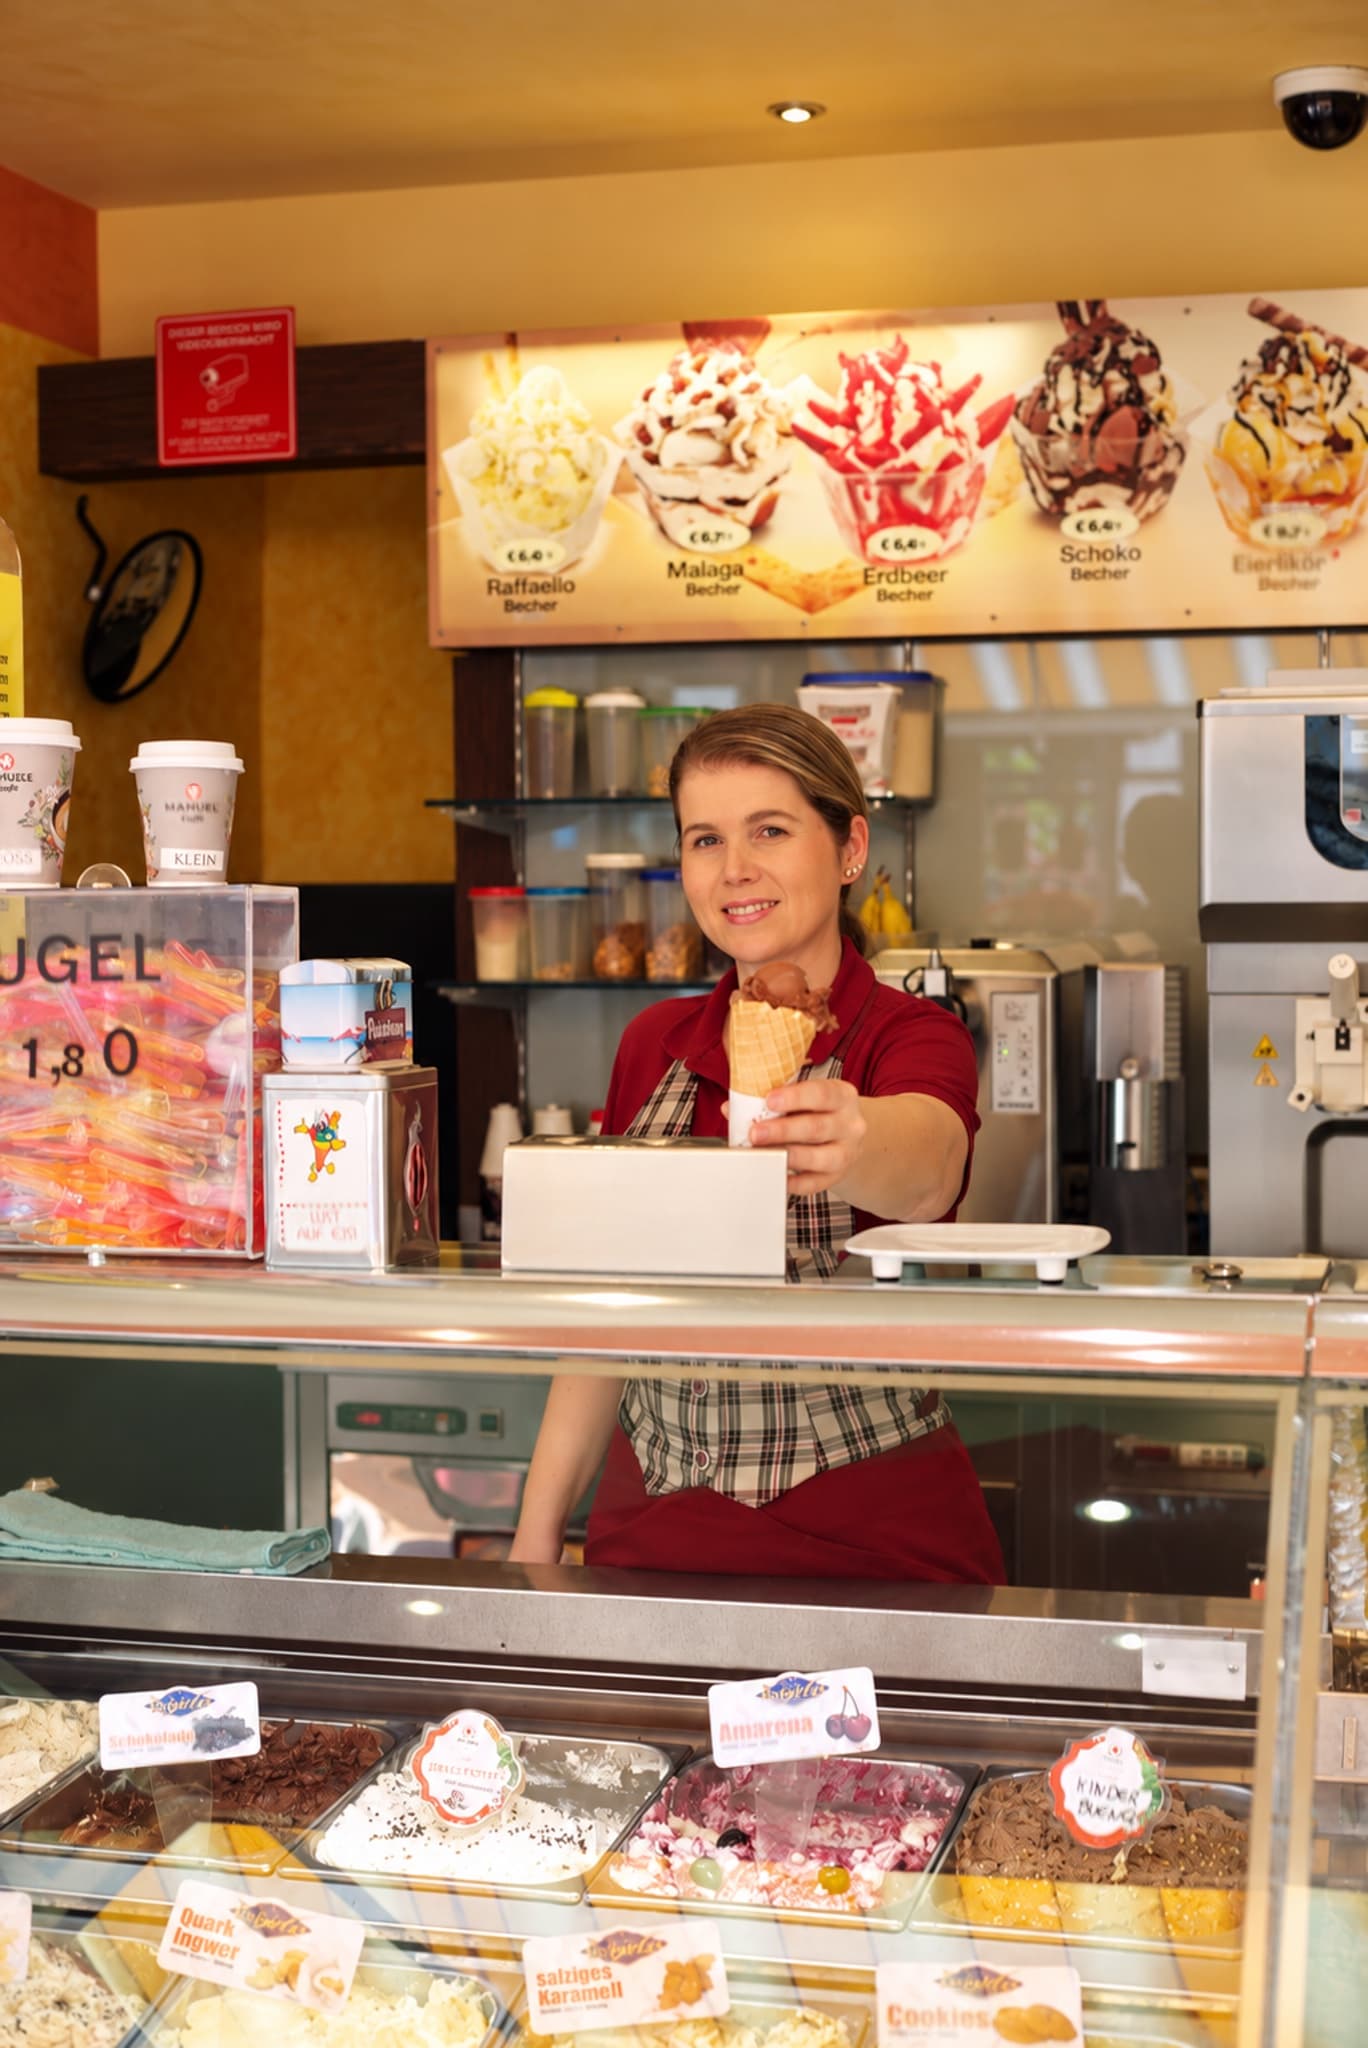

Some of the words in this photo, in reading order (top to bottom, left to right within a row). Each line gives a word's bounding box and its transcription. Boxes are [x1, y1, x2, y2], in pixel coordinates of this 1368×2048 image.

[1060, 544, 1142, 563] Schoko
[667, 560, 744, 581] Malaga
[863, 566, 949, 586] Erdbeer
[1071, 567, 1130, 581] Becher
[487, 576, 576, 596] Raffaello
[685, 582, 742, 597] Becher
[877, 588, 934, 602] Becher
[504, 598, 558, 613] Becher
[165, 802, 218, 813] MANUEL
[0, 850, 33, 865] OSS
[174, 853, 217, 866] KLEIN
[108, 1729, 195, 1749] Schokolade
[719, 1716, 814, 1743] Amarena
[1077, 1776, 1140, 1806] KINDER
[180, 1907, 235, 1938] Quark
[172, 1927, 241, 1961] Ingwer
[536, 1965, 613, 1988] salziges
[538, 1981, 624, 2007] Karamell
[887, 2004, 992, 2029] Cookies
